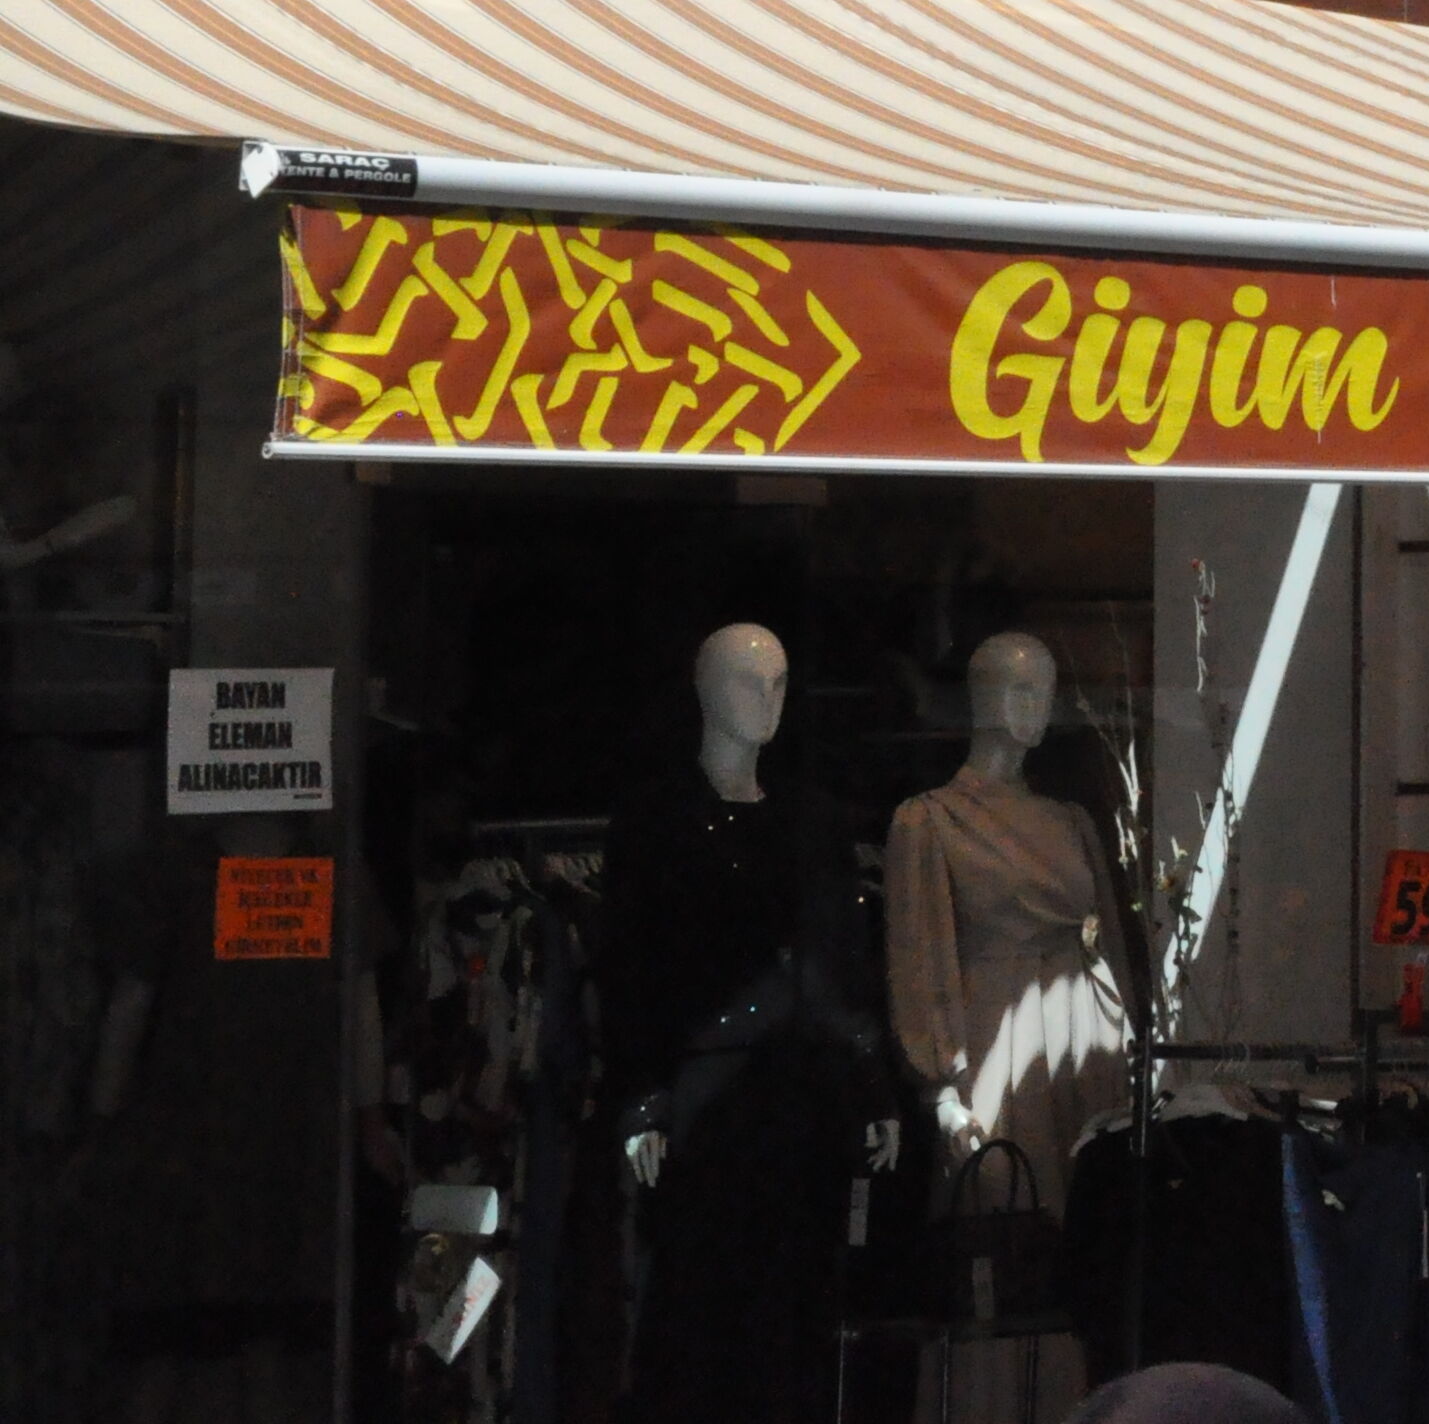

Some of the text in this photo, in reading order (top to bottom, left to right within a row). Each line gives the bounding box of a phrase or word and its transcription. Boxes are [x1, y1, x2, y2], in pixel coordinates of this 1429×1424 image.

[299, 152, 391, 171] SARAÇ
[949, 260, 1400, 465] Giyim
[216, 681, 286, 710] BAYAN
[208, 721, 293, 751] ELEMAN
[177, 761, 323, 792] ALINACAKTIR
